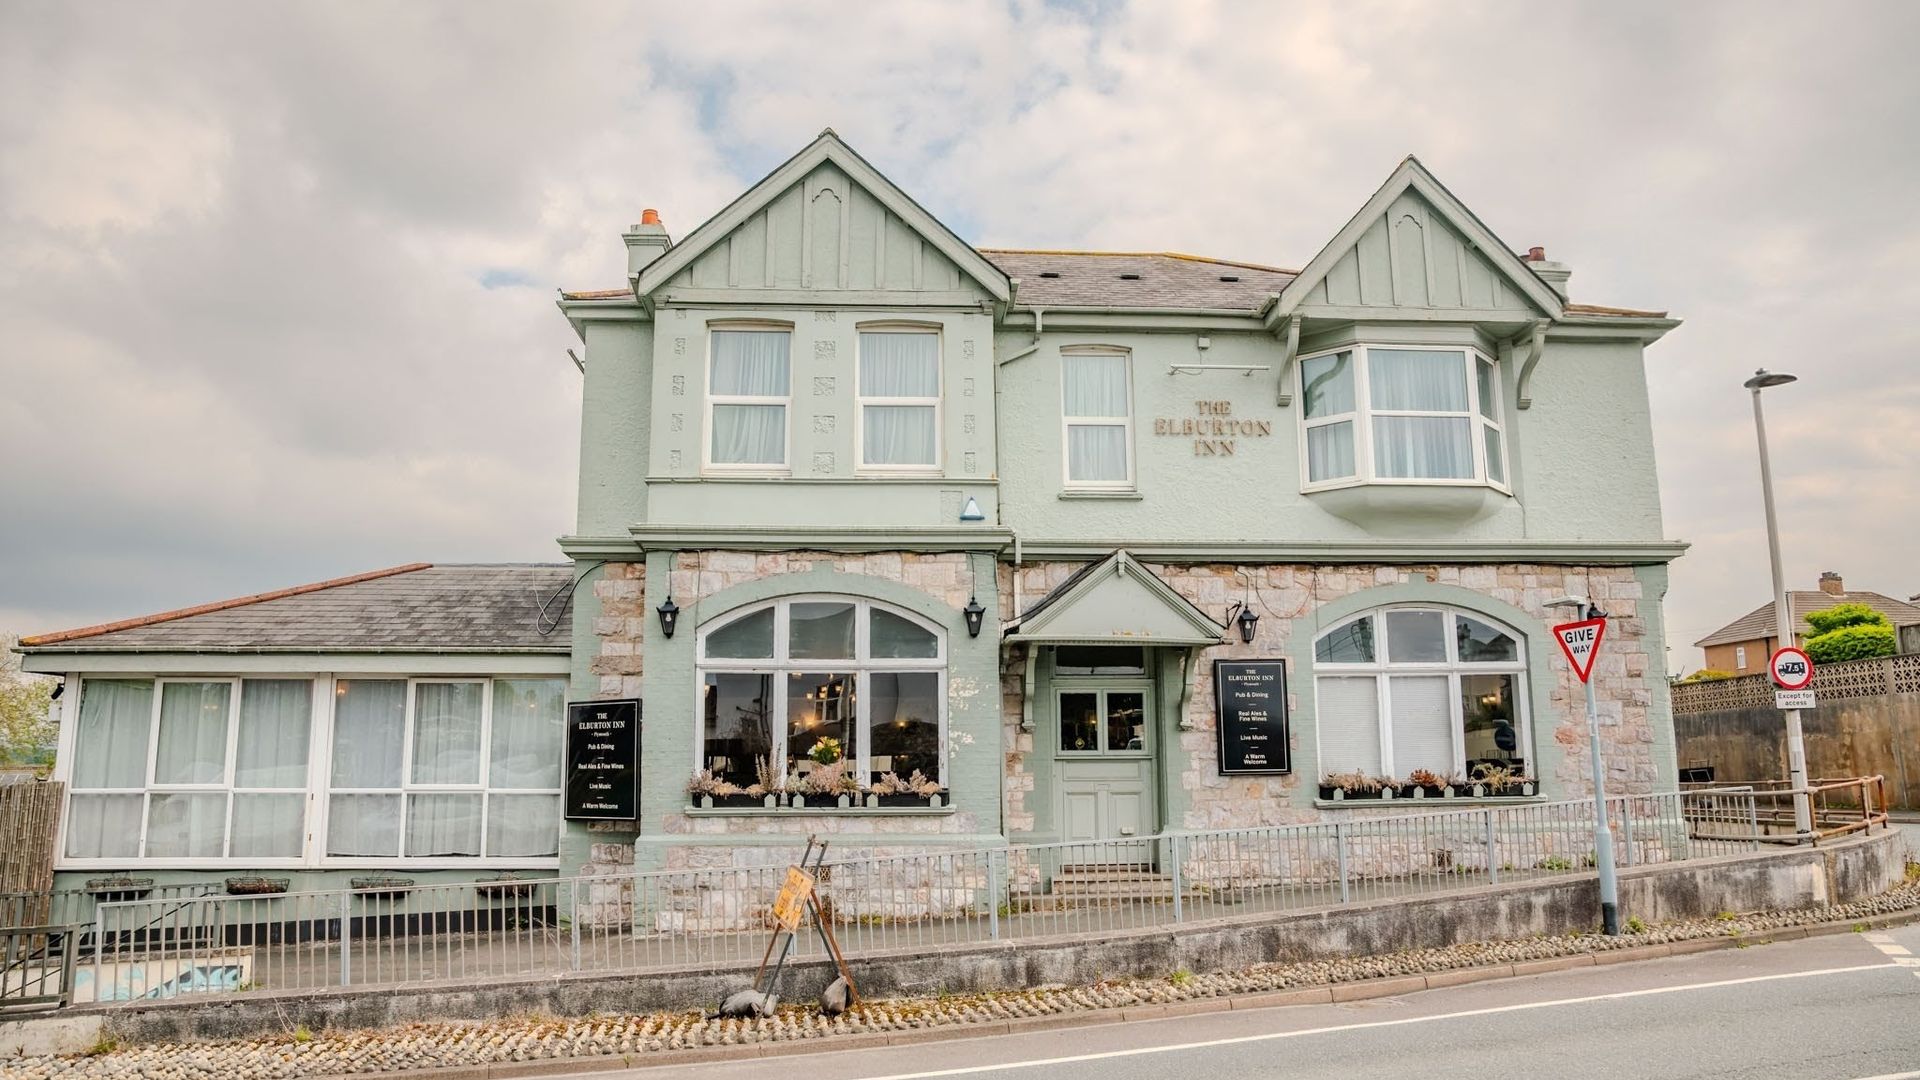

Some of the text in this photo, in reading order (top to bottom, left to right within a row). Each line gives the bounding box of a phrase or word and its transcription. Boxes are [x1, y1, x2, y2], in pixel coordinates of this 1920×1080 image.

[1195, 400, 1232, 415] THE
[1154, 418, 1271, 437] ELBURTON
[1194, 439, 1235, 456] INN
[1565, 628, 1594, 643] GIVE
[1572, 644, 1590, 654] WAY
[578, 720, 626, 730] ELBURTON INN
[600, 743, 615, 751] Dining
[599, 802, 619, 810] Welcome
